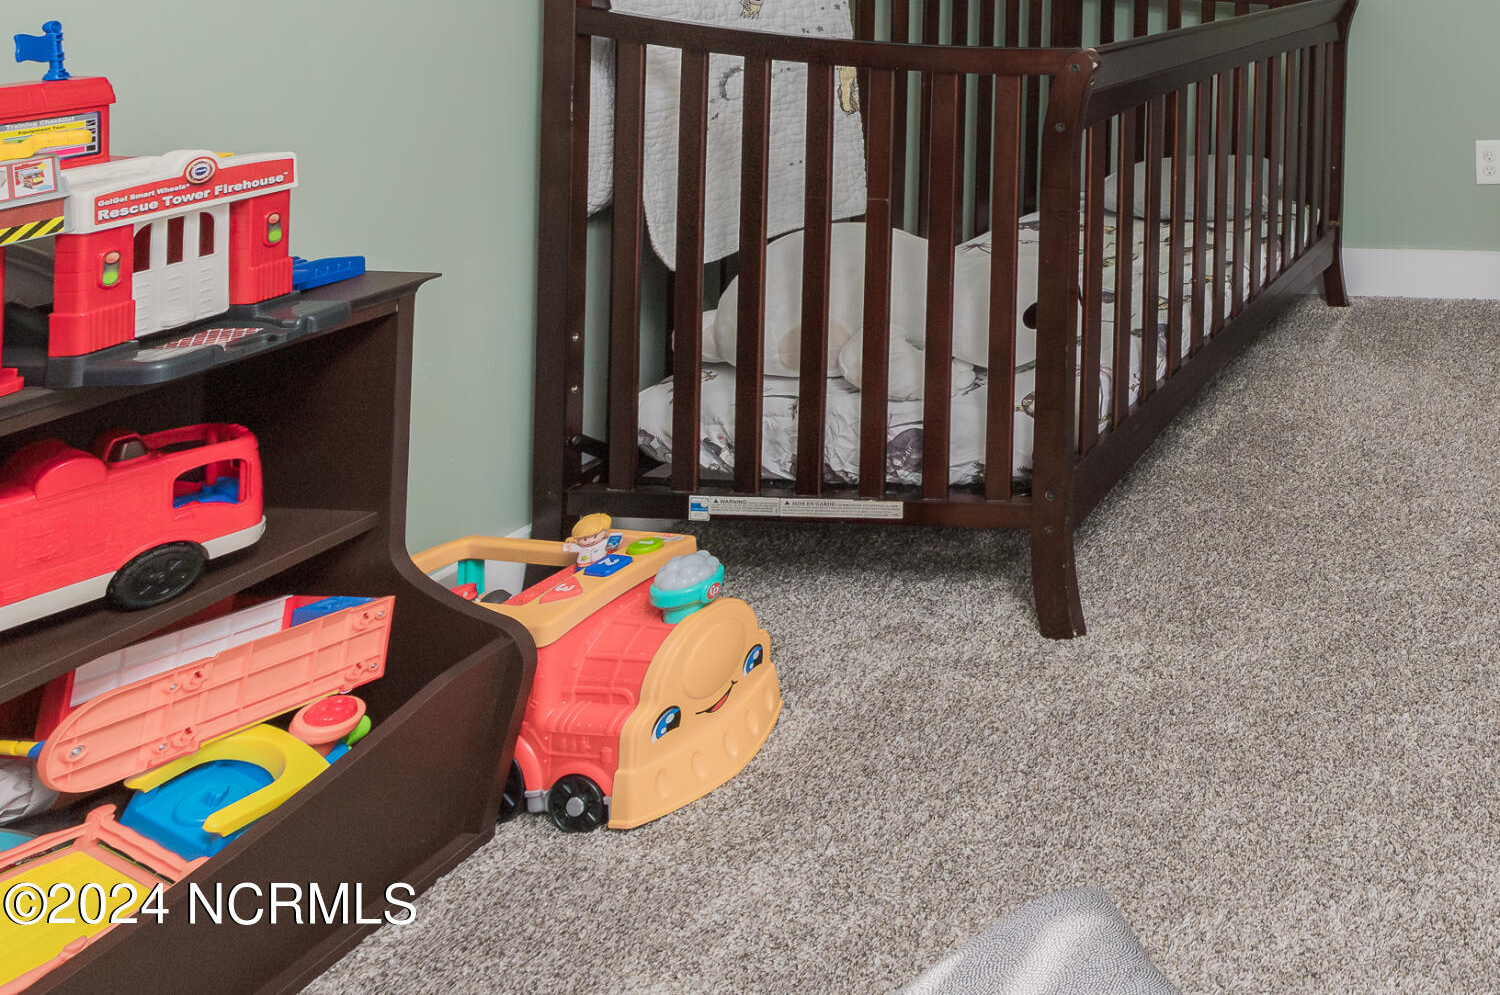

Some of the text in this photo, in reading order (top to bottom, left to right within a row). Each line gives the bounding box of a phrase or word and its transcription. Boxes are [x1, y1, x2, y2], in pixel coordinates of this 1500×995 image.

[97, 200, 159, 222] Rescue
[162, 188, 211, 207] Tower
[130, 189, 155, 201] Smart
